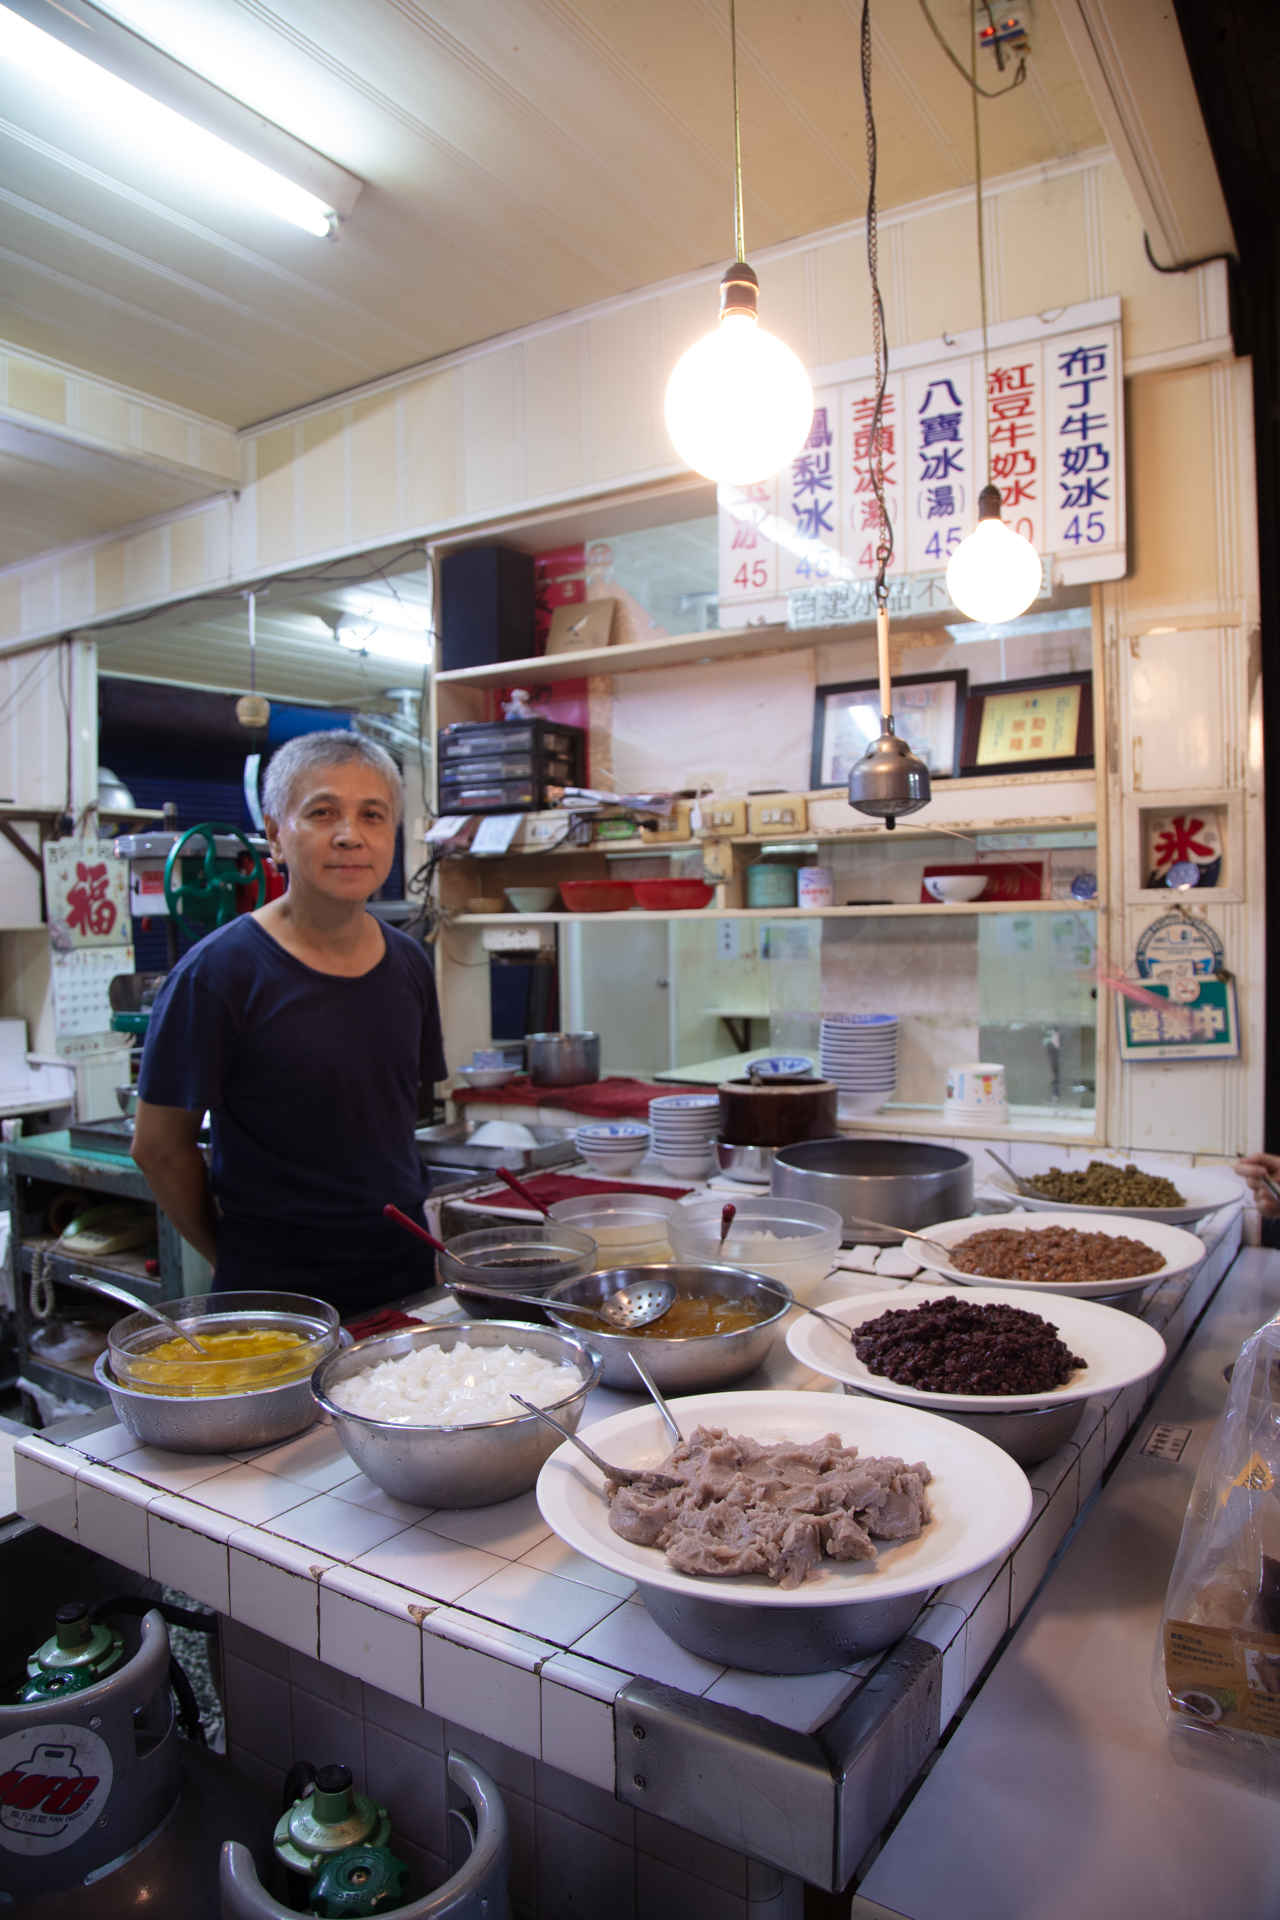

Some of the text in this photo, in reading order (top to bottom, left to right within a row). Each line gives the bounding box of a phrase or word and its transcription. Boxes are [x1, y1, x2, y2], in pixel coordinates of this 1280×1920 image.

[987, 363, 1038, 507] 紅豆牛奶冰
[1057, 344, 1110, 510] 布丁牛奶冰
[925, 527, 963, 560] 45
[1063, 511, 1107, 546] 45
[733, 559, 769, 589] 45
[795, 549, 831, 580] 45
[65, 861, 118, 937] 福
[1129, 1003, 1226, 1042] 營業中
[10, 1810, 48, 1824] 南方瓦斯
[65, 1810, 84, 1823] FANG
[83, 1798, 95, 1812] GAS
